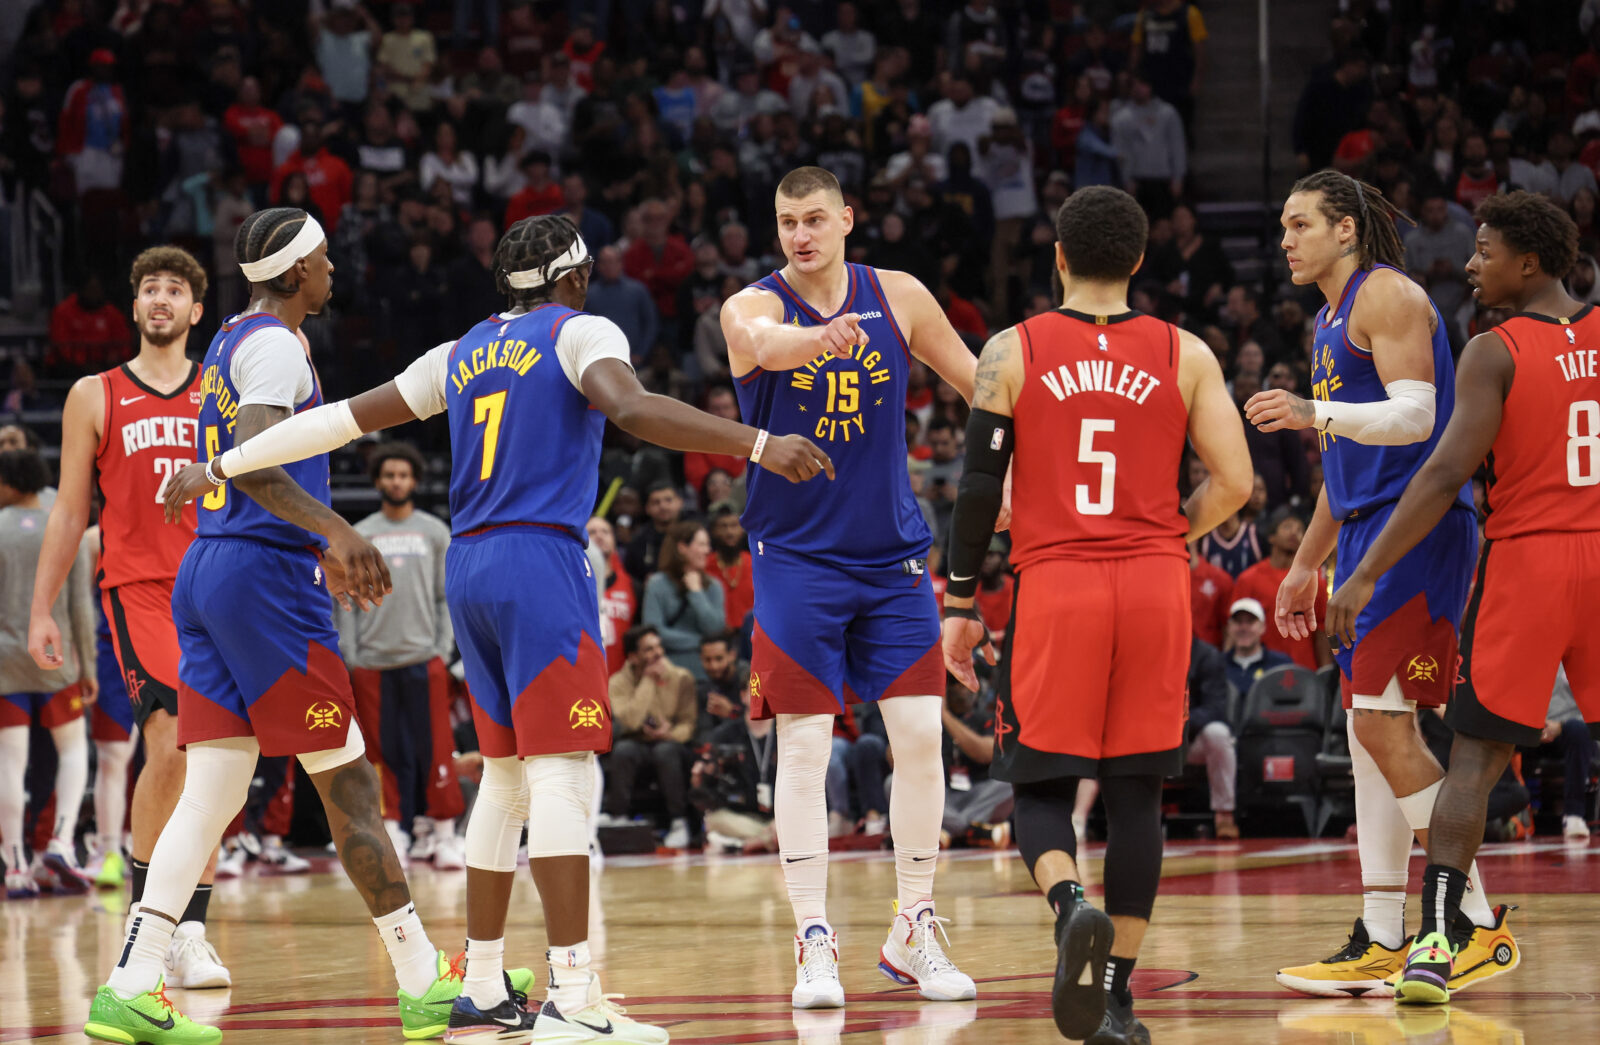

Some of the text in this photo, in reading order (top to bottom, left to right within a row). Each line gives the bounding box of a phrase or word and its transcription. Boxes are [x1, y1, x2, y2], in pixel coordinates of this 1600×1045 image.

[861, 310, 882, 320] otta
[451, 339, 542, 394] JACKSON
[1040, 360, 1160, 405] VANVLEET
[1555, 350, 1598, 382] TATE
[826, 371, 860, 413] 15
[121, 416, 199, 457] ROCKET
[473, 389, 508, 482] 7
[815, 413, 865, 442] CITY
[1566, 400, 1600, 486] 8
[1075, 418, 1117, 516] 5
